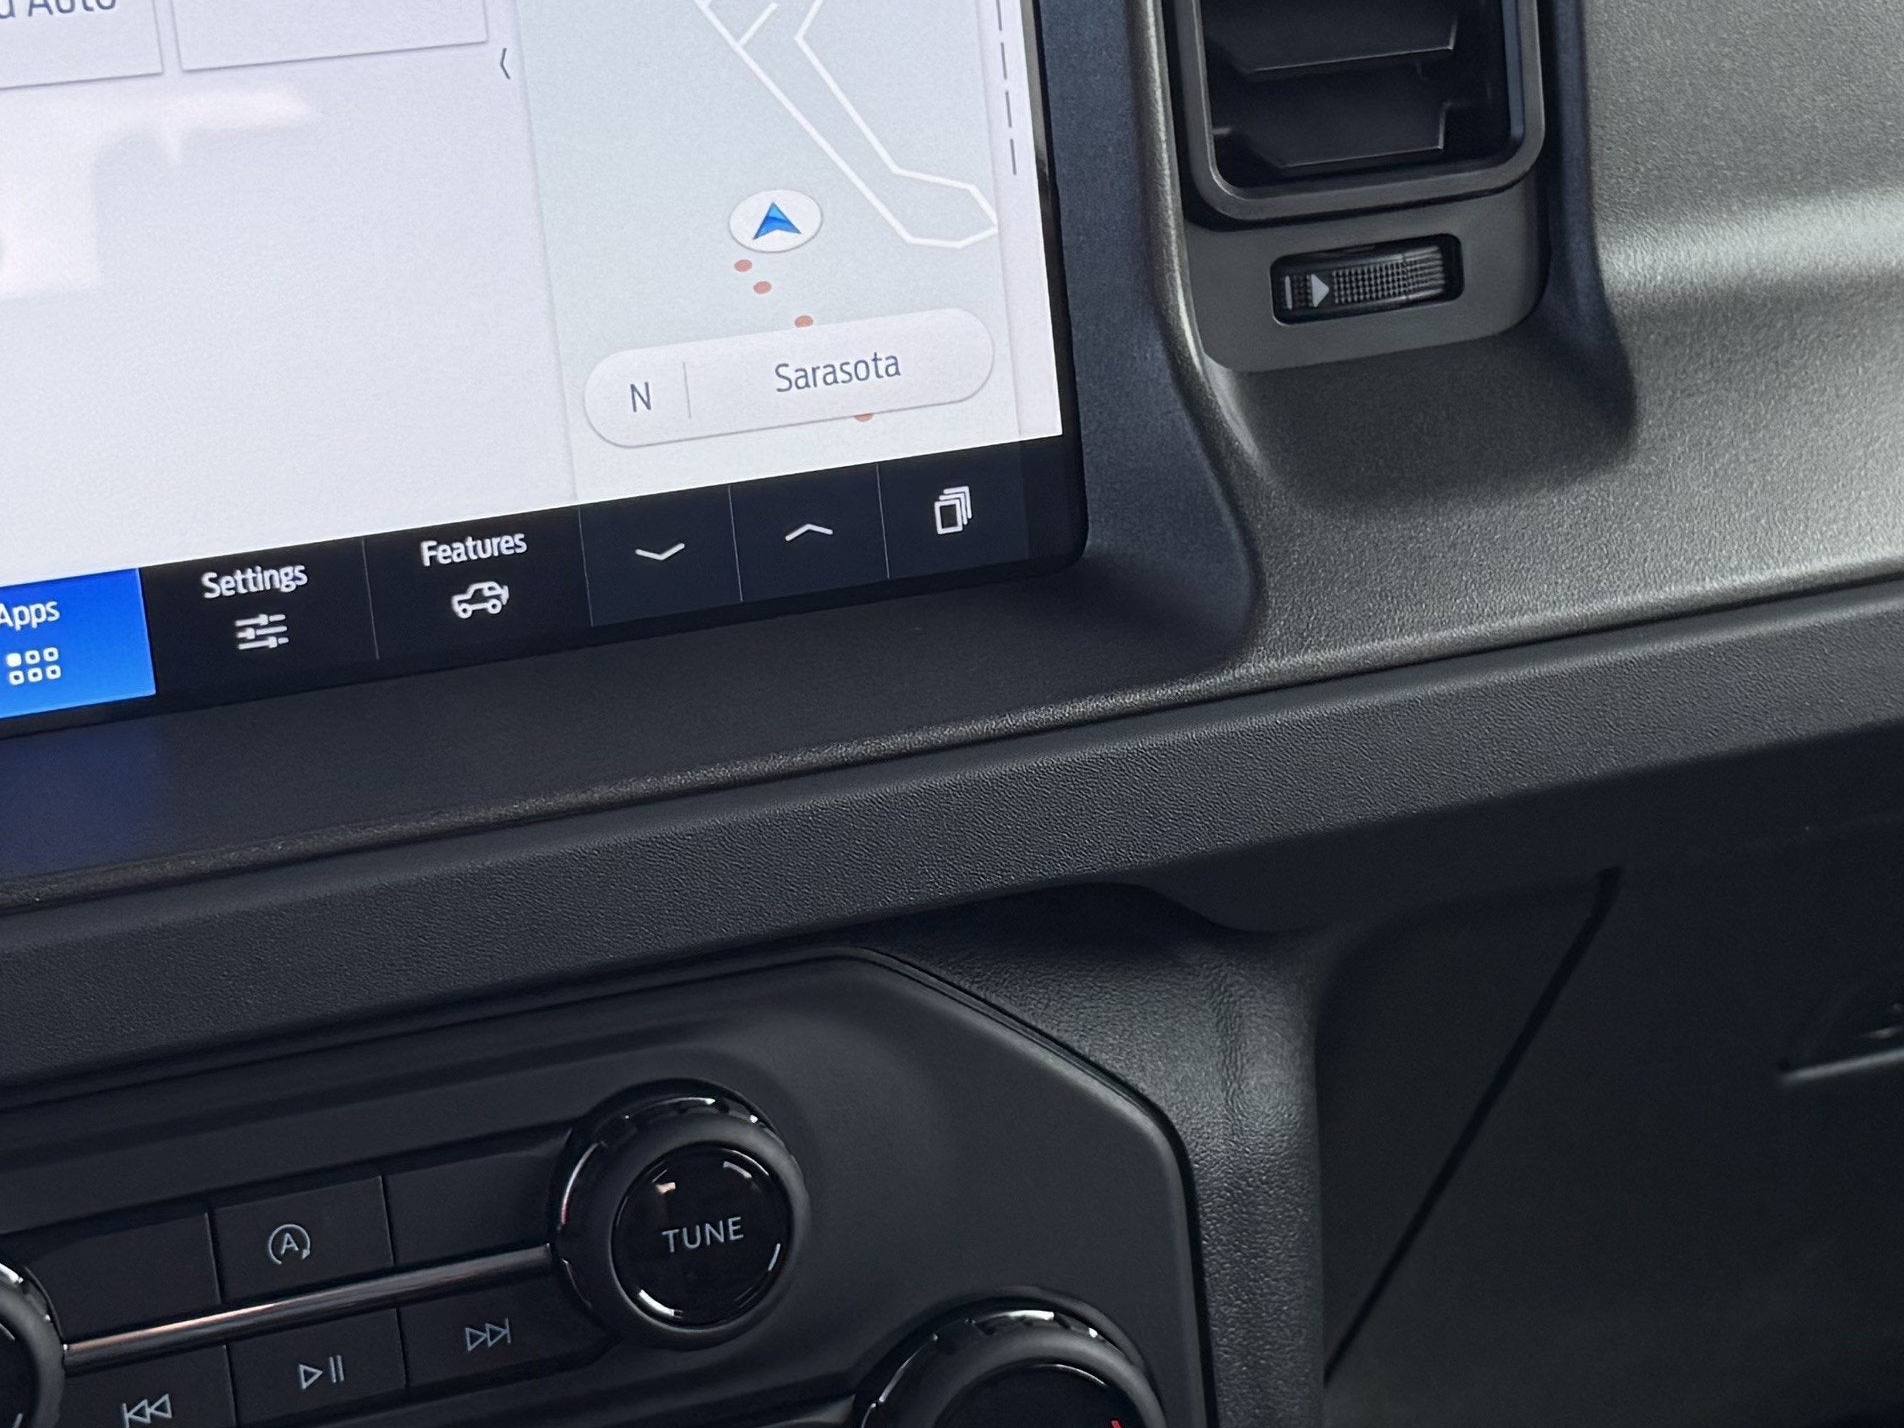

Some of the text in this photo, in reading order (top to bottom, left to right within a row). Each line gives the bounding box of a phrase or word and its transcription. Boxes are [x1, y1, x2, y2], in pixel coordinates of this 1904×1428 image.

[629, 348, 902, 414] N Sarasota
[420, 527, 528, 569] Features
[201, 560, 309, 602] Settings
[661, 1215, 745, 1255] TUNE
